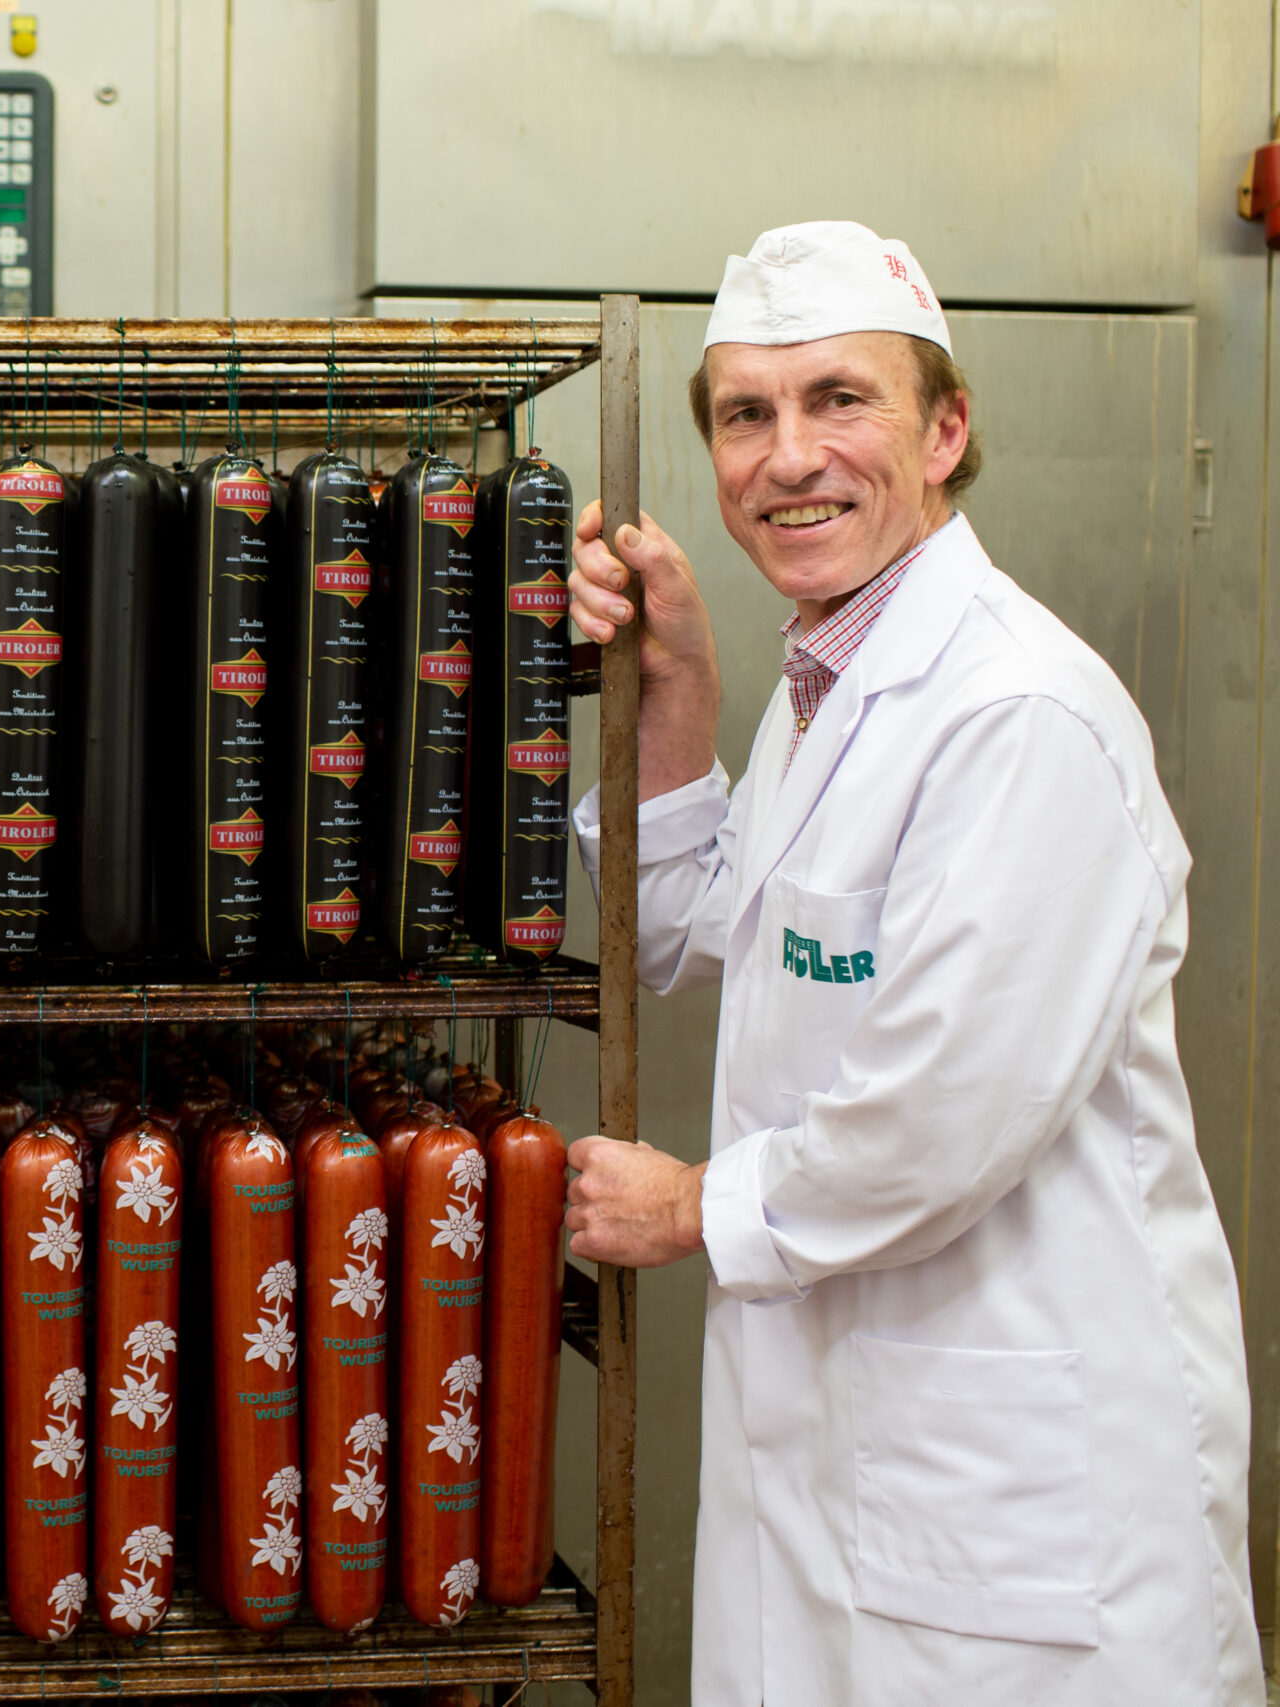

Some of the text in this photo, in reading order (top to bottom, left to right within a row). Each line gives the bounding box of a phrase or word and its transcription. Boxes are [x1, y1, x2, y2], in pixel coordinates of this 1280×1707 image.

[1, 478, 62, 494] TIROLER
[223, 487, 271, 501] TIROLE
[322, 572, 370, 585] TIROLE
[515, 593, 568, 605] TIROLE
[218, 672, 267, 684] TIROLE
[318, 754, 365, 766] TIROLE
[515, 750, 570, 763] TIROLE
[217, 830, 263, 843] TIROLE
[314, 910, 360, 922] TIROLE
[512, 927, 565, 940] TIROLE
[234, 1179, 295, 1197] TOURISTE
[121, 1258, 174, 1271] WURST
[421, 1275, 484, 1291] TOURISTE
[21, 1286, 85, 1304] TOURISTE
[323, 1333, 388, 1350] TOURISTE
[238, 1385, 298, 1404] TOURISTE
[117, 1463, 170, 1477] WURST
[419, 1478, 481, 1496] TOURISTE
[25, 1492, 87, 1511] TOURISTE
[324, 1538, 388, 1555] TOURISTE
